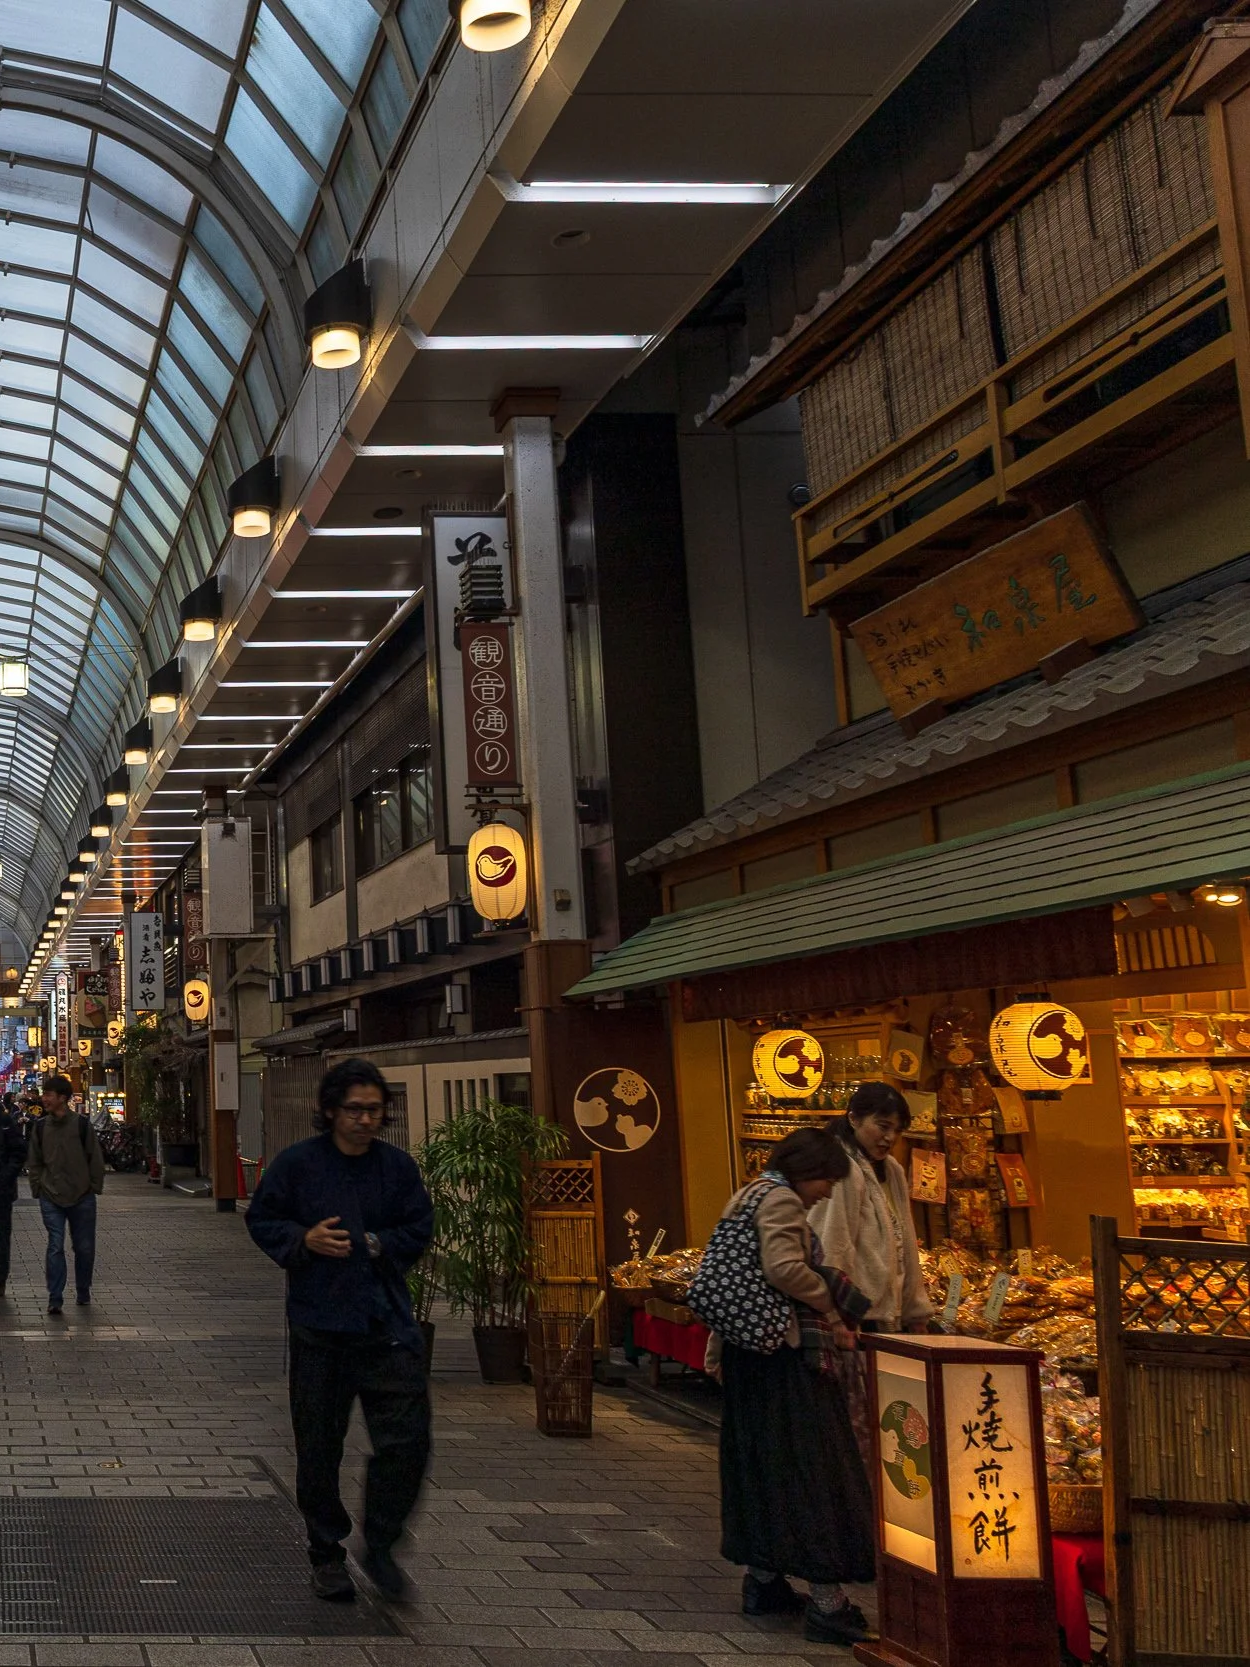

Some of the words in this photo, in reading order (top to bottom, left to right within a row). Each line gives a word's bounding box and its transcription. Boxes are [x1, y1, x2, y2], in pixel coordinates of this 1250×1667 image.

[469, 636, 509, 775] 観音通り
[962, 1371, 1020, 1562] 手焼煎餅
